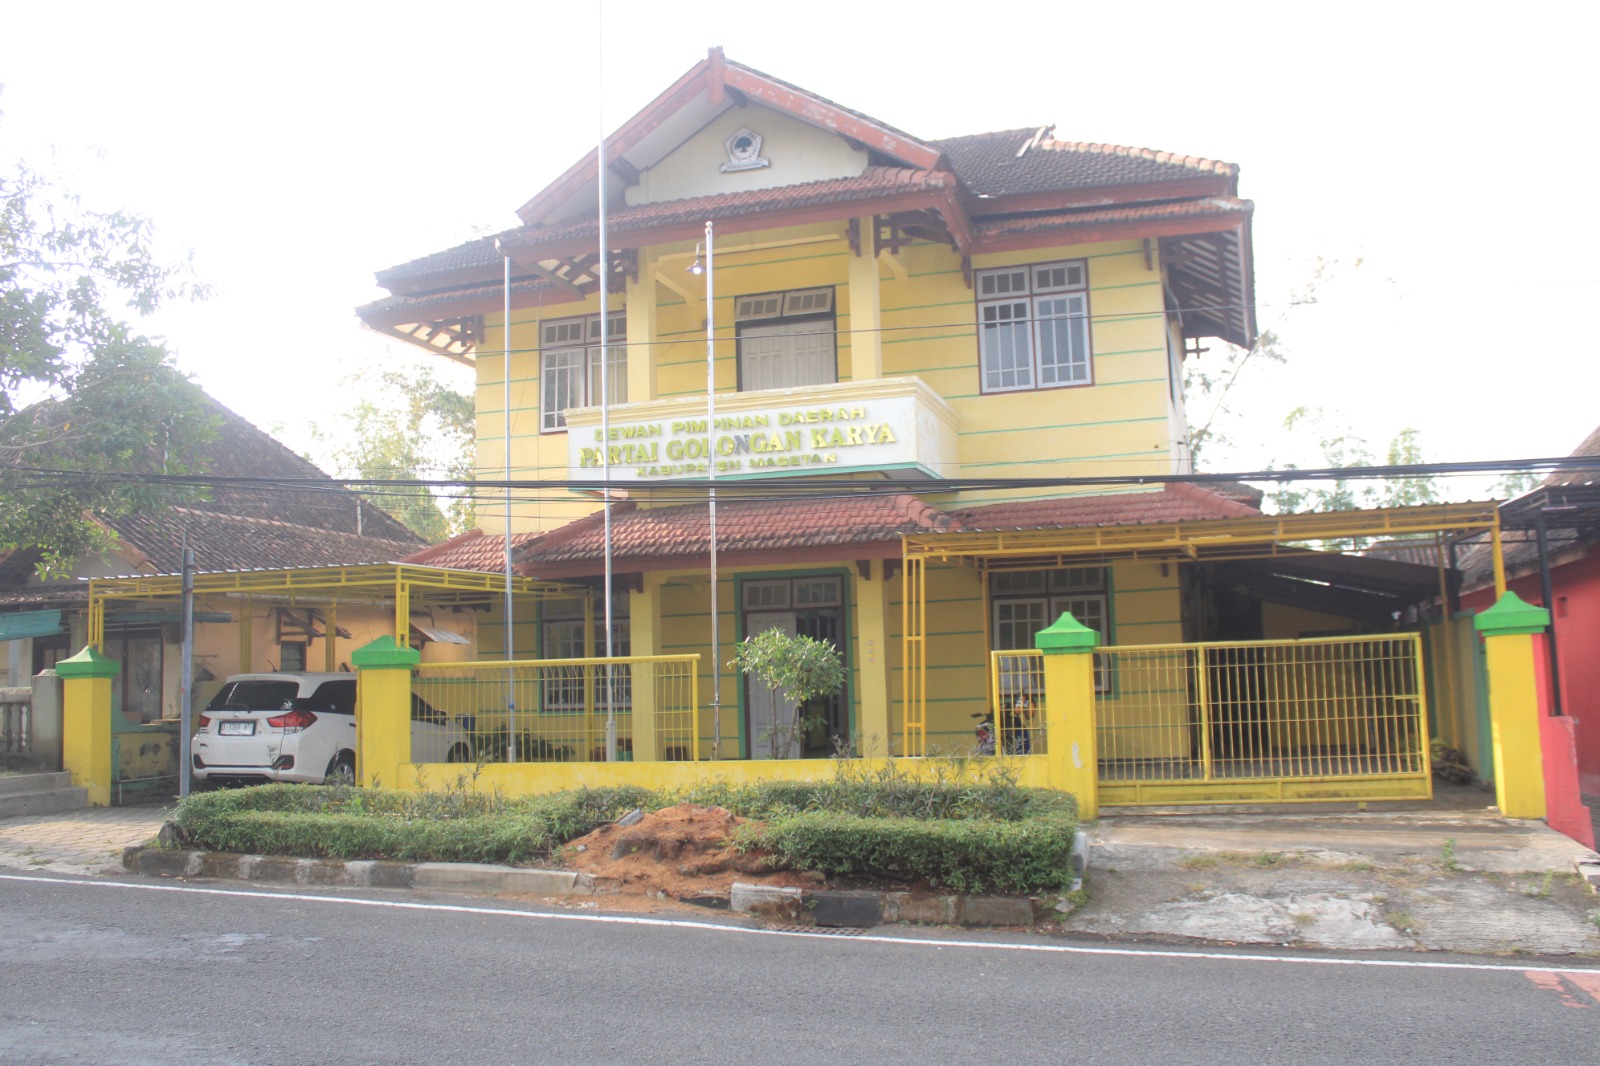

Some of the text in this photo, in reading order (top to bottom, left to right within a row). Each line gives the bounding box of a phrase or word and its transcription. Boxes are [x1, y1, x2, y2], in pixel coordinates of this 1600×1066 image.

[594, 405, 866, 441] DEWAN PIMPINAN DAERAH
[579, 441, 659, 467] PARTAI
[810, 422, 897, 449] KARYA
[635, 452, 837, 477] KABUPAEN MAGETAN
